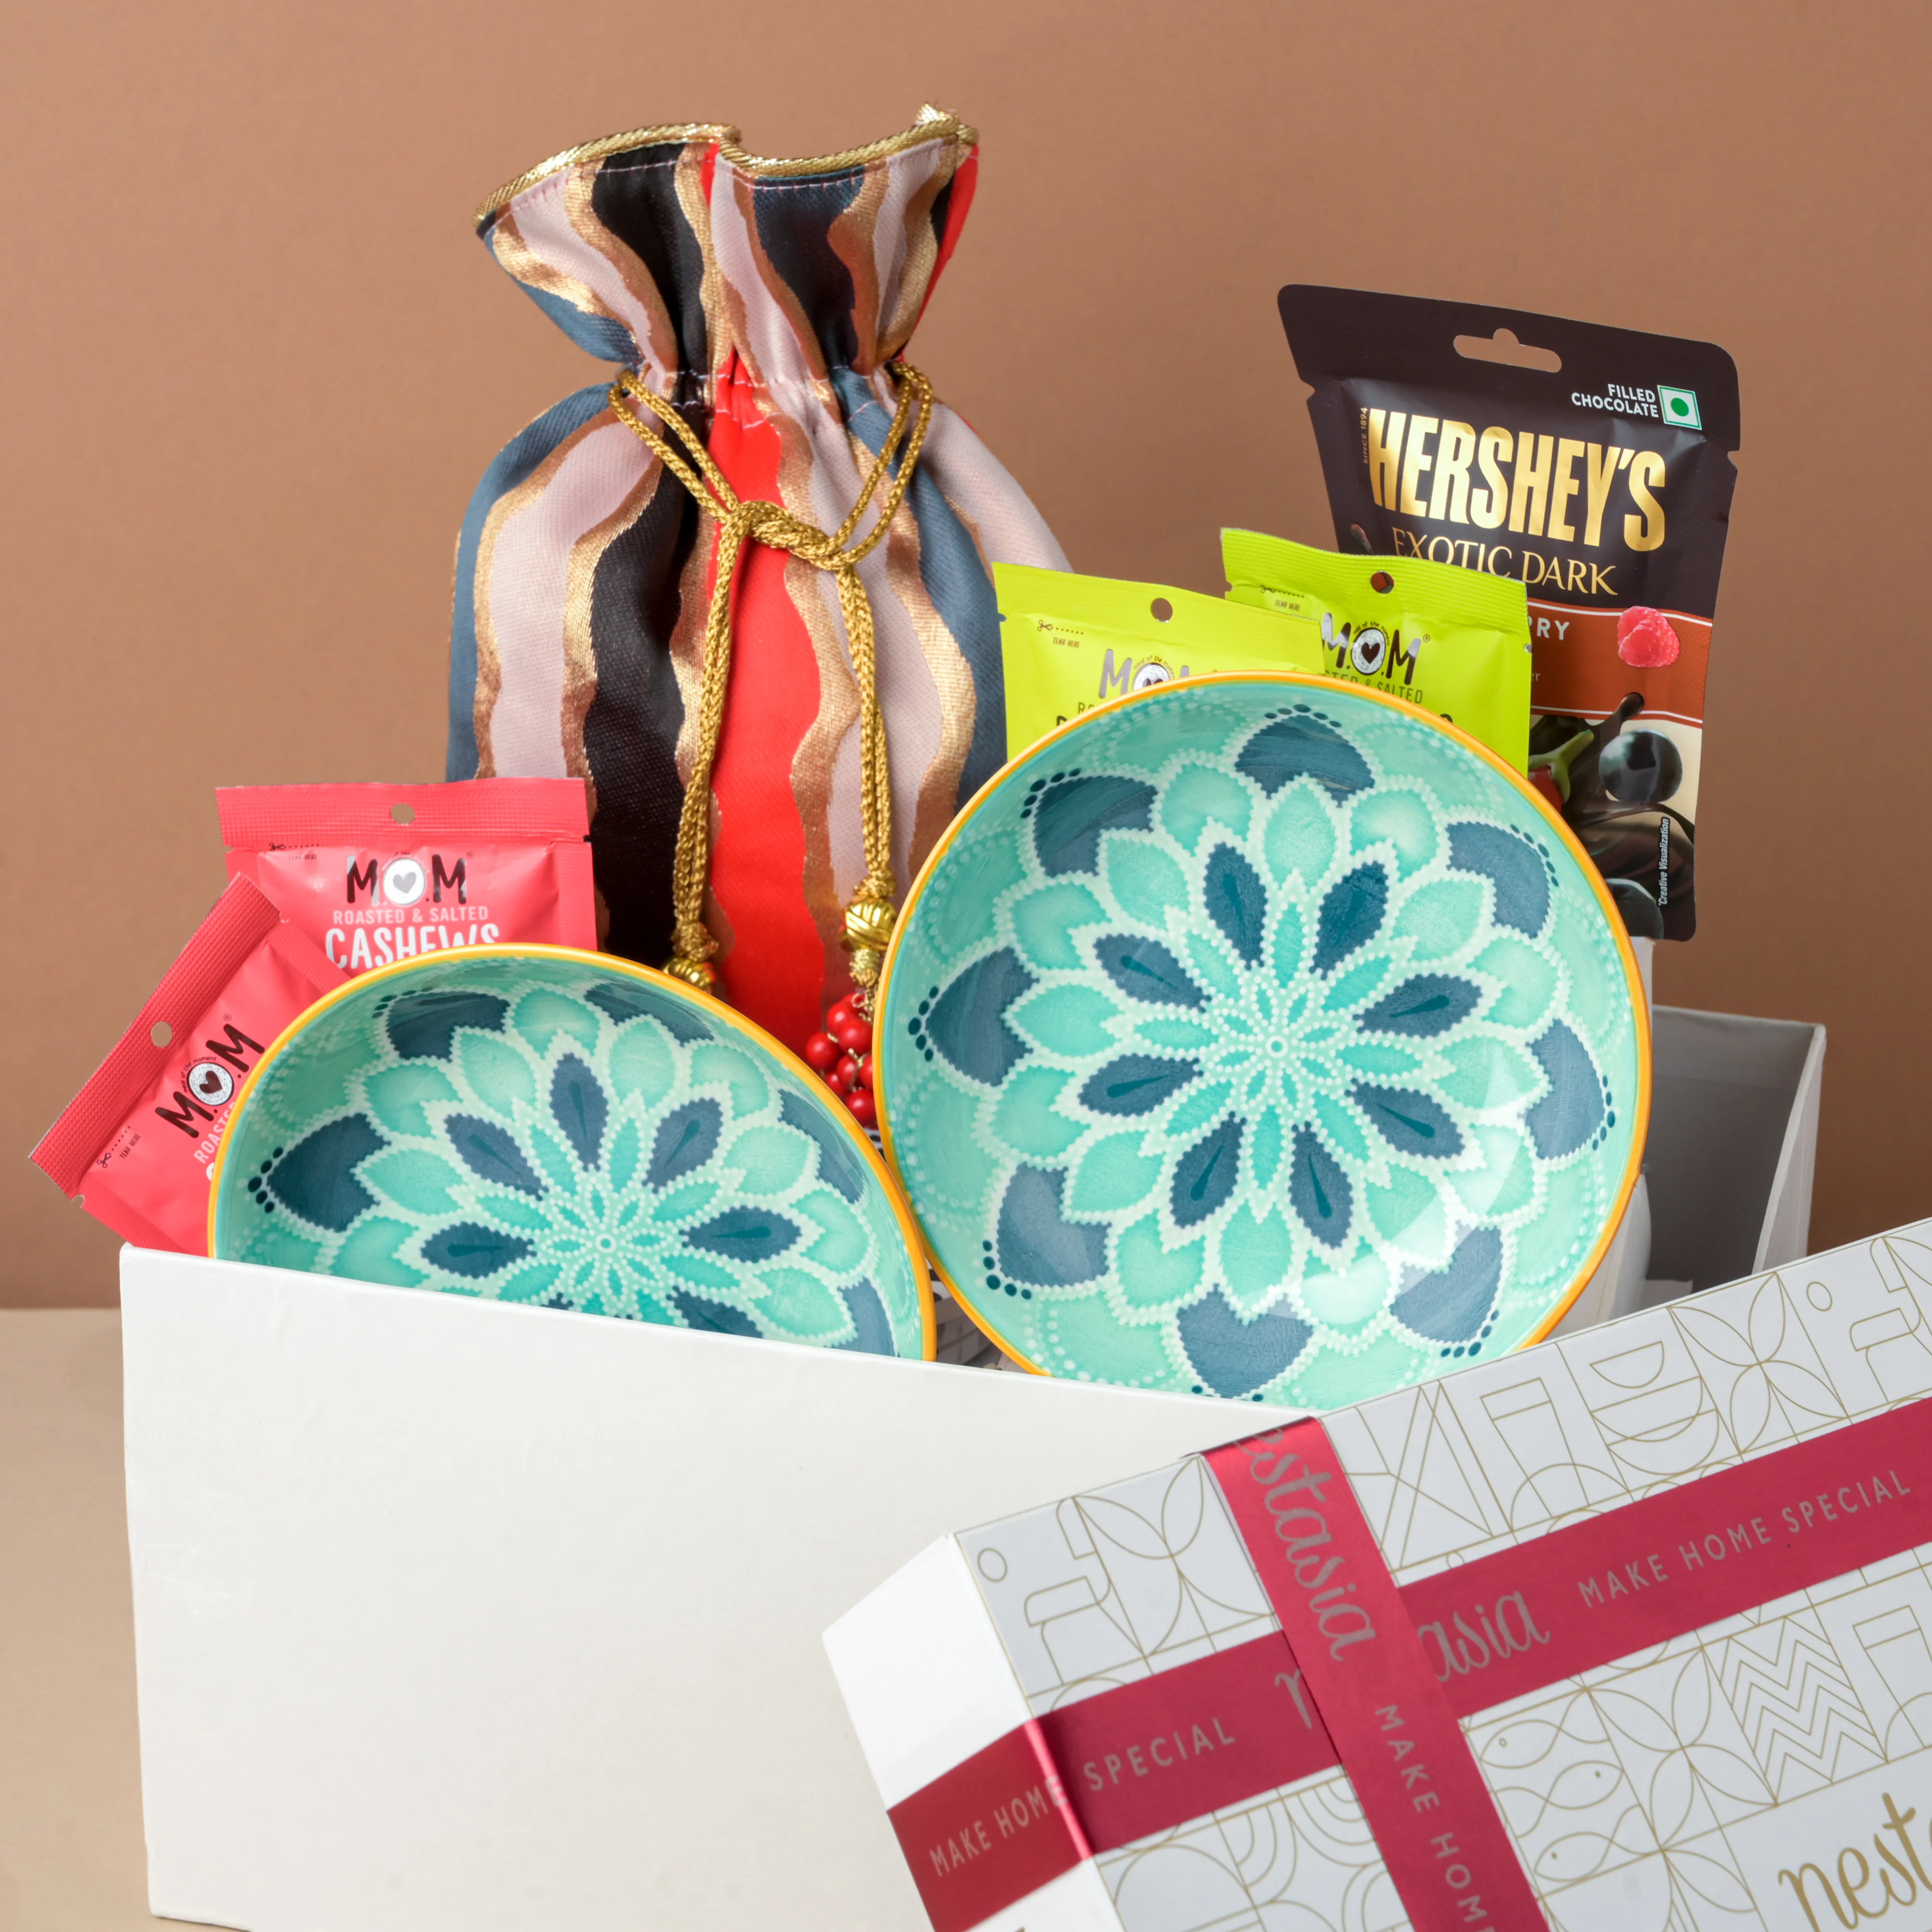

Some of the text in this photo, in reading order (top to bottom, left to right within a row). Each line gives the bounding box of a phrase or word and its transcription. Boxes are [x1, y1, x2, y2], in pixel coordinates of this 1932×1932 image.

[1571, 393, 1659, 418] CHOCOLATE
[1608, 384, 1655, 403] FILLED
[1369, 408, 1665, 551] HERSHEY'S
[1392, 527, 1618, 595] EXOTIC DARK
[1659, 818, 1669, 870] Visualization
[333, 906, 488, 925] ROASTED & SALTED
[193, 1101, 235, 1164] ROAST
[1577, 1554, 1668, 1607] MAKE
[1679, 1517, 1771, 1571] HOME
[1782, 1470, 1911, 1533] SPECIAL
[929, 1717, 1235, 1877] MAKE HOME SPECIAL
[1375, 1704, 1440, 1813] MAKE
[1430, 1832, 1496, 1932] HOM
[1778, 1792, 1932, 1932] nest
